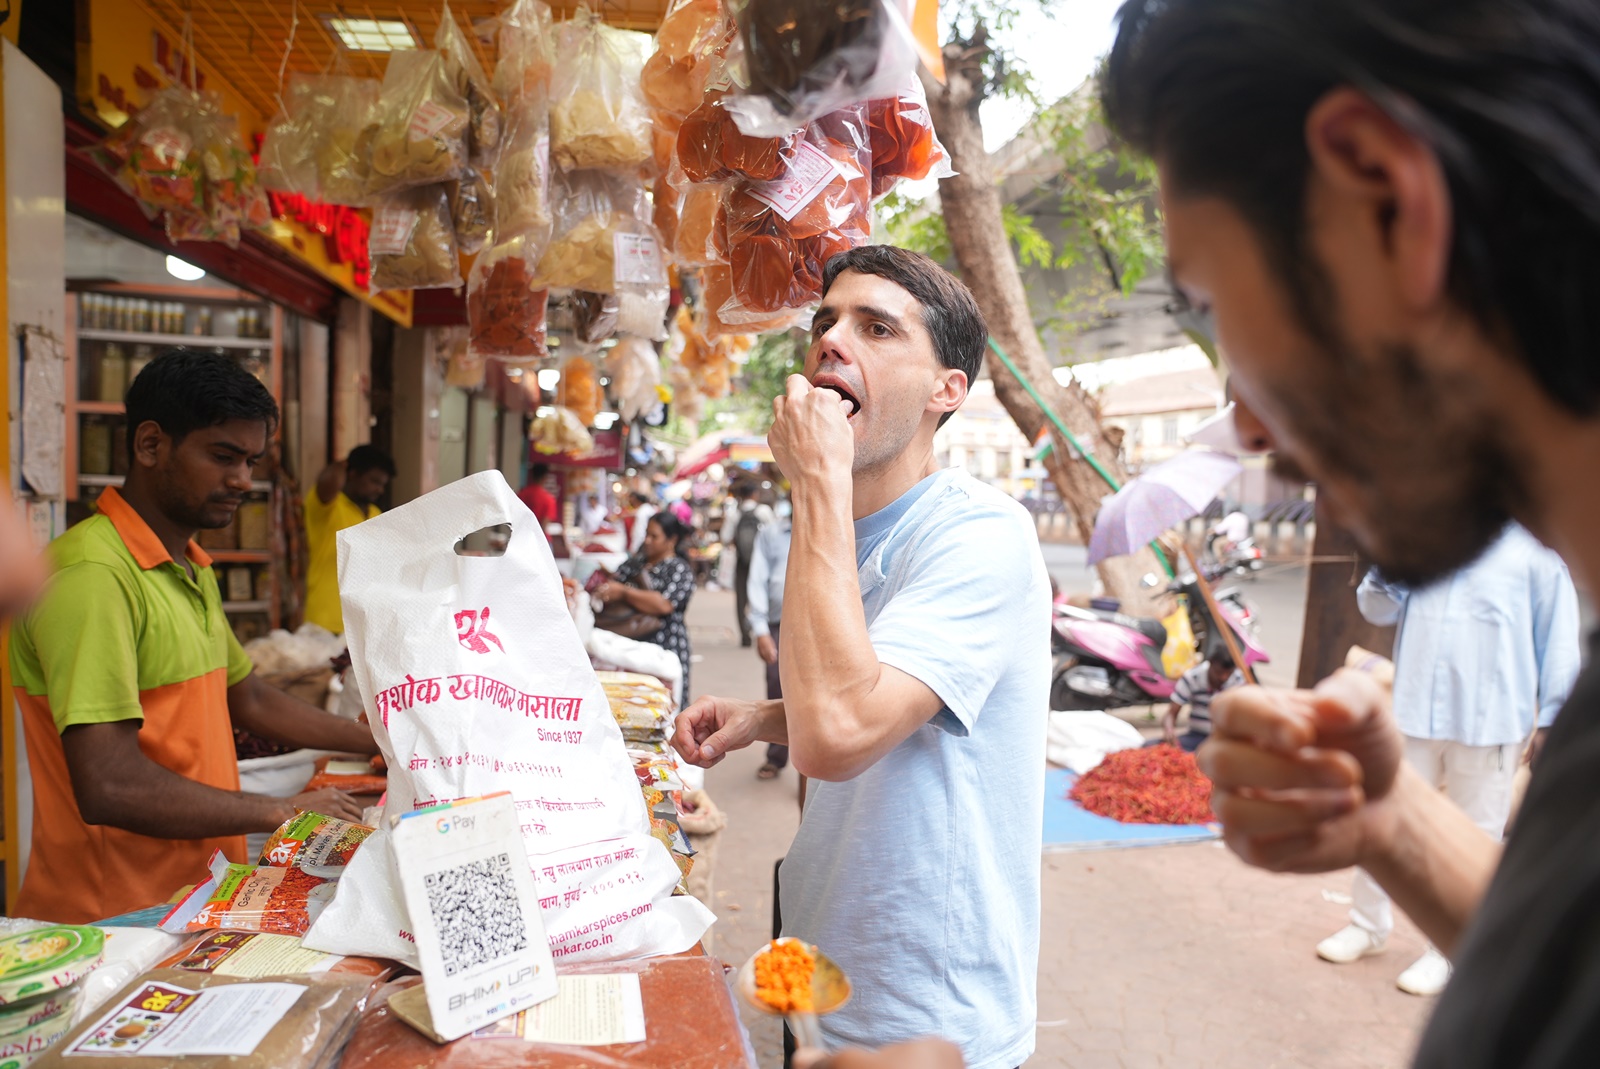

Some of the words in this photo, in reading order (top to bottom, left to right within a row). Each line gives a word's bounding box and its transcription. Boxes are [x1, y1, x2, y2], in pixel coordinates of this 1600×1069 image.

[447, 674, 517, 712] खामकर
[517, 690, 584, 722] मसाला
[537, 727, 562, 743] Since
[563, 729, 583, 745] 1937
[452, 814, 476, 830] Pay
[556, 857, 592, 877] लालबाग
[593, 853, 613, 868] राजा
[564, 882, 582, 908] मुंबई
[547, 902, 653, 946] hamkarspices.com
[551, 933, 614, 958] mkar.co.in
[448, 982, 496, 1011] BHIM
[507, 964, 536, 987] UPI
